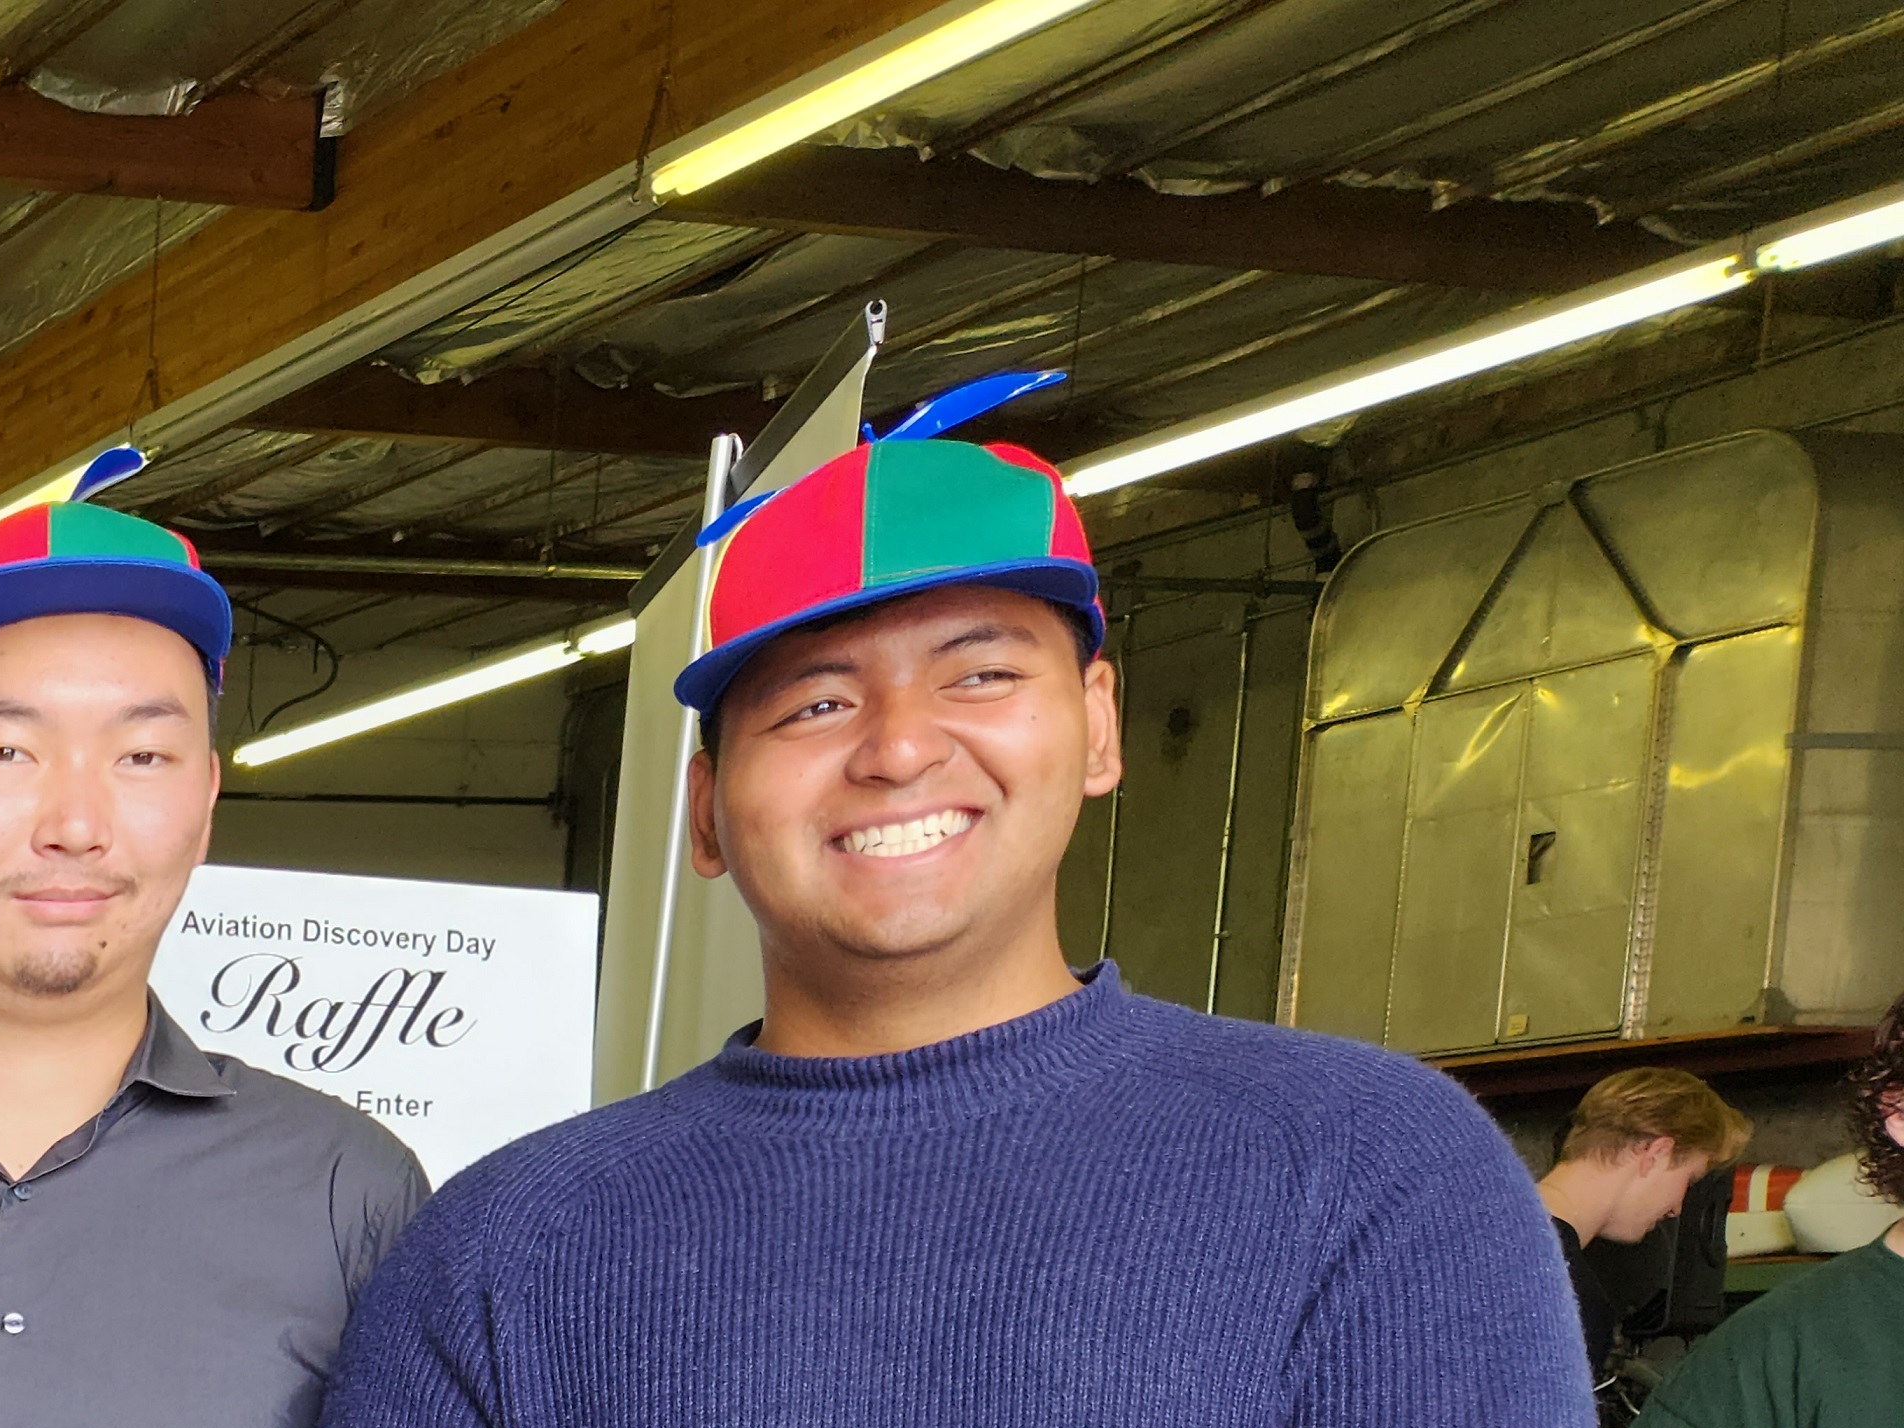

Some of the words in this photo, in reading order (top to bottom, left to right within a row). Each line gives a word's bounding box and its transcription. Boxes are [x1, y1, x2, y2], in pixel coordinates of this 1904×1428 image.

[181, 910, 292, 941] Aviation
[303, 918, 437, 957] Discovery
[446, 928, 496, 961] Day
[200, 952, 478, 1073] Raffle
[357, 1089, 434, 1118] Enter
